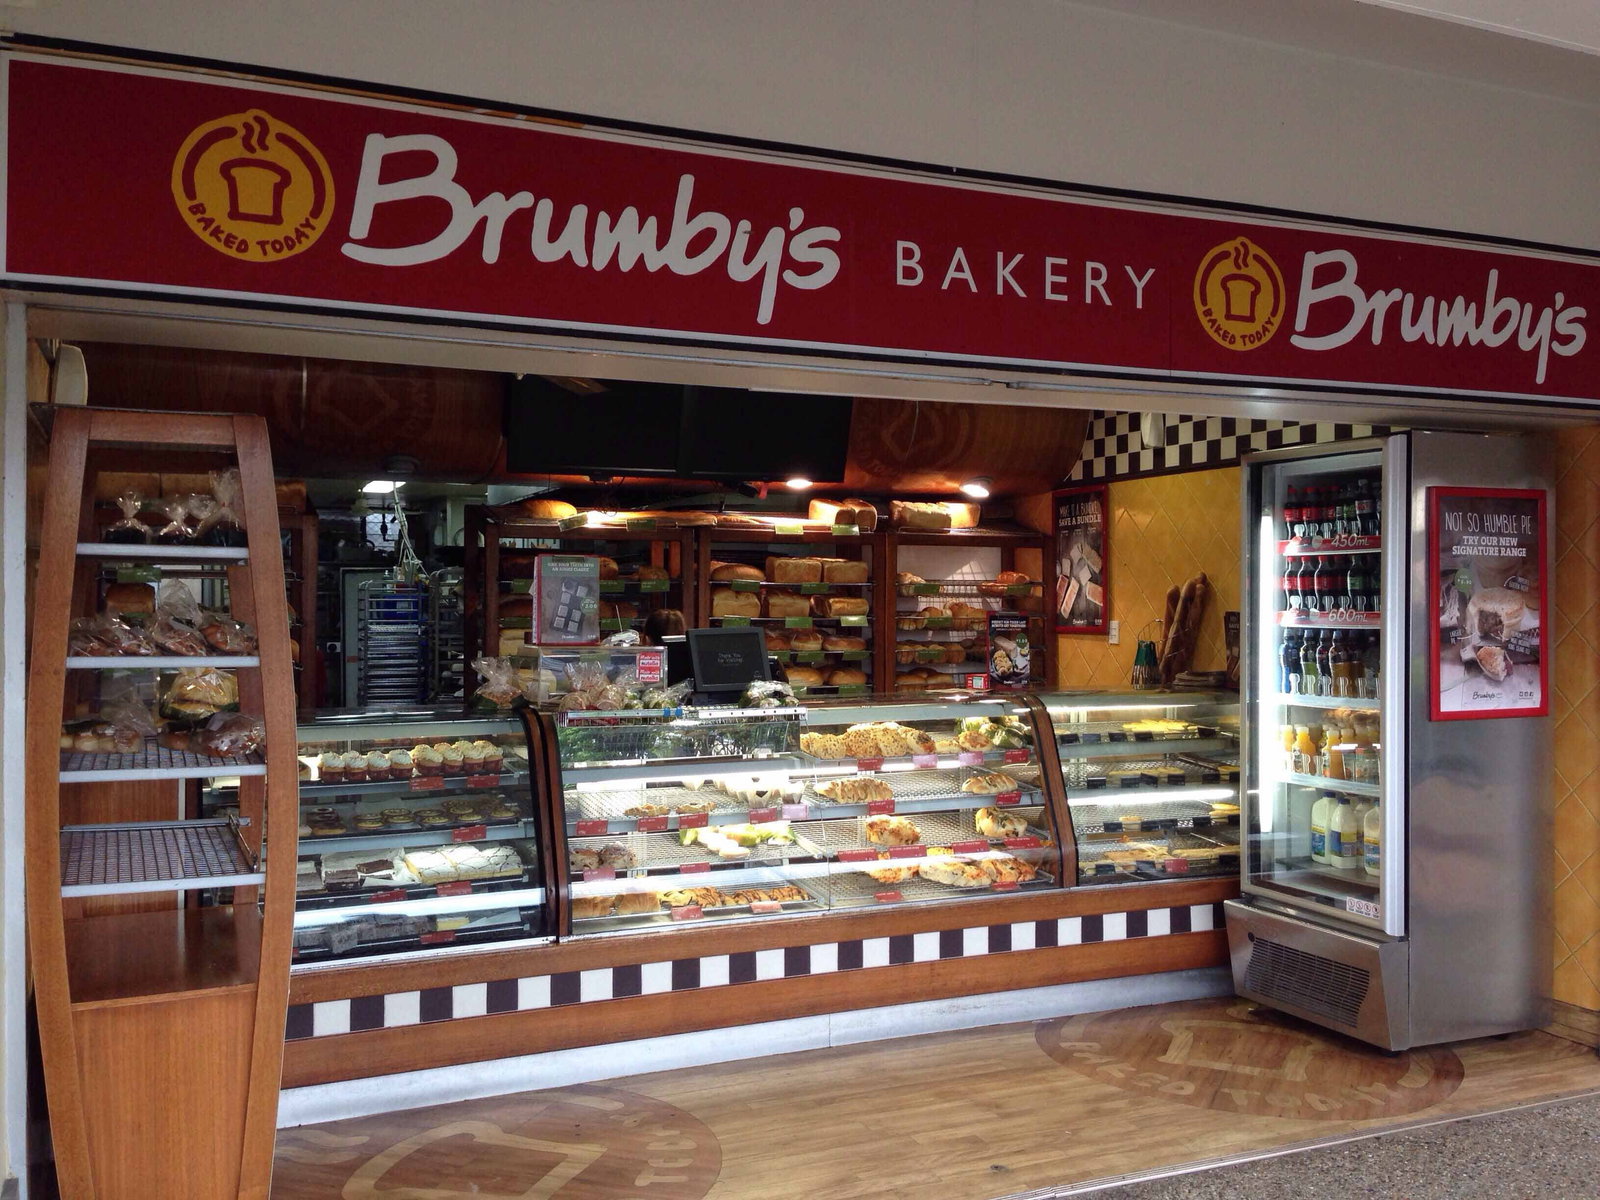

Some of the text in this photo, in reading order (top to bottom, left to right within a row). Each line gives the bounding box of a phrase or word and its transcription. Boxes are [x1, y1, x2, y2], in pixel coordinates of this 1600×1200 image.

[188, 202, 316, 257] BAKED TODAY
[340, 132, 842, 325] Brumby's
[896, 240, 1156, 309] BAKERY
[1202, 307, 1275, 347] BAKED TODAY
[1290, 249, 1587, 385] Brumby's
[1059, 517, 1071, 527] SAVE
[1077, 513, 1102, 525] BUNDLE
[1445, 511, 1532, 535] NOT SO HUMBLE PIE
[1452, 546, 1527, 557] SIGNATURE RANGE
[1462, 535, 1518, 546] TRY OUR NEW
[1328, 608, 1368, 622] 600mL
